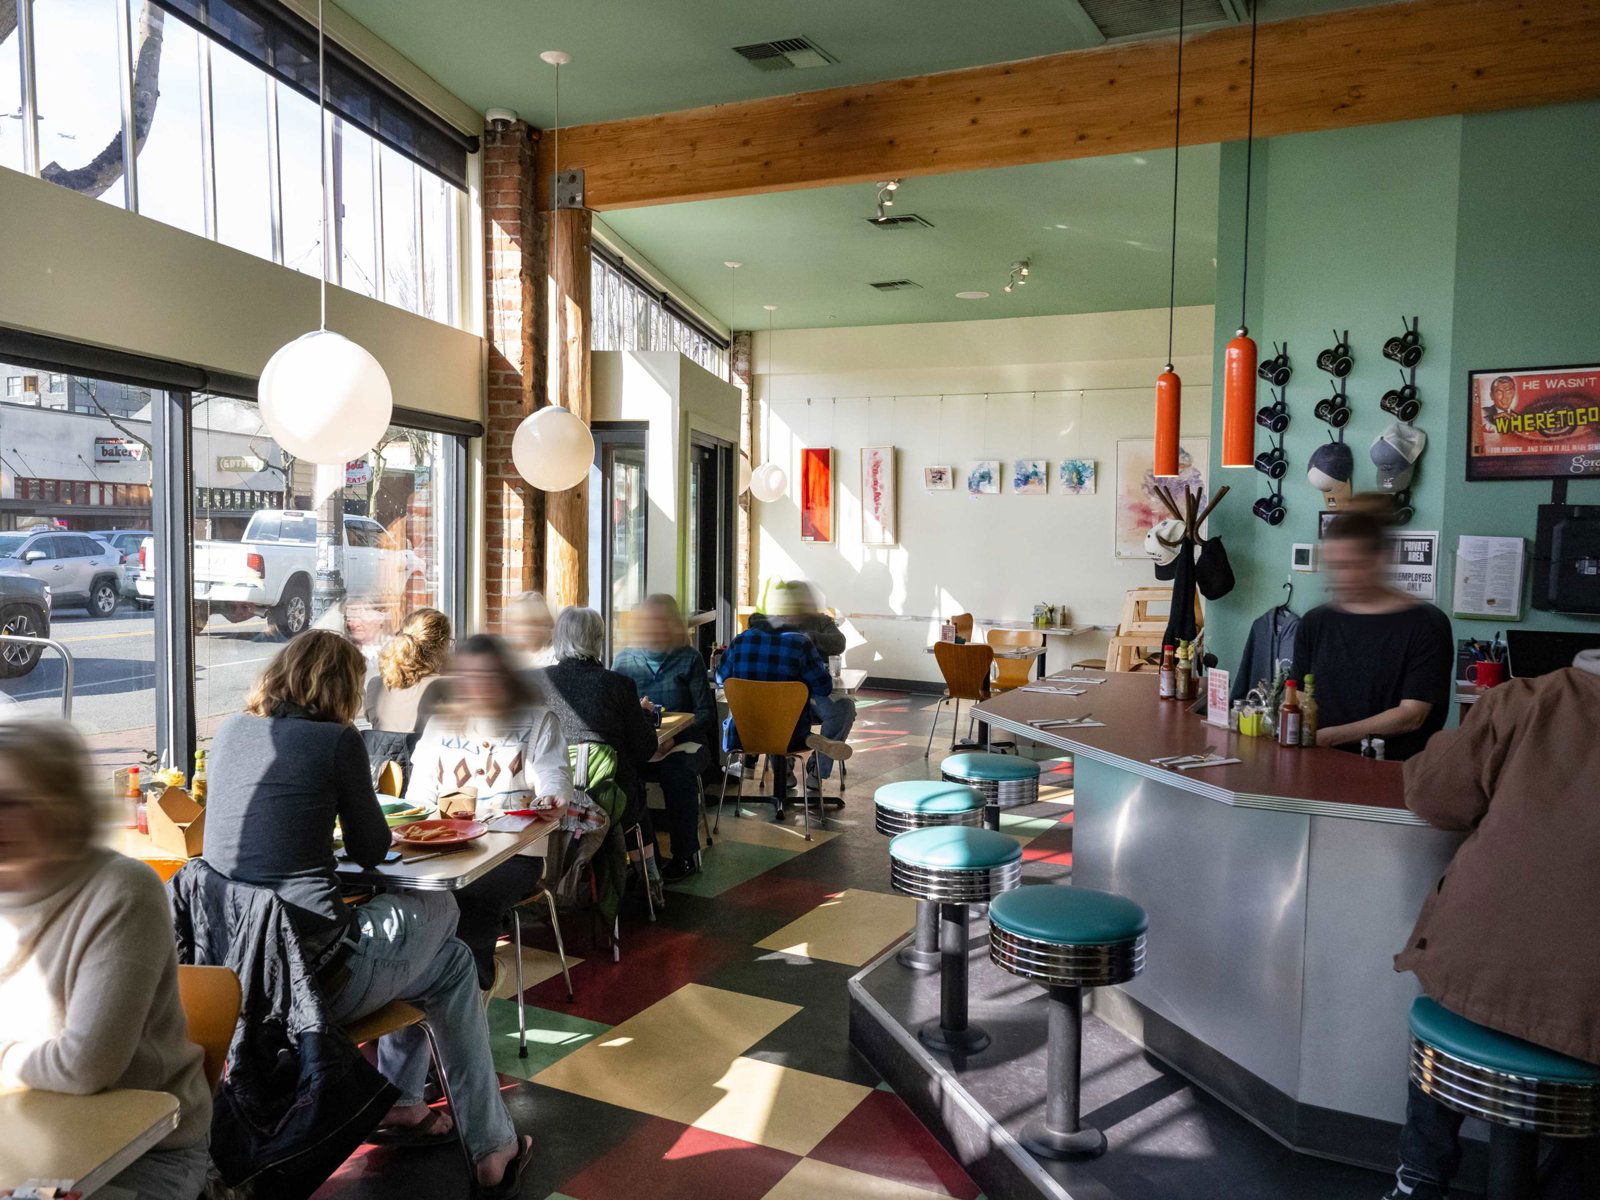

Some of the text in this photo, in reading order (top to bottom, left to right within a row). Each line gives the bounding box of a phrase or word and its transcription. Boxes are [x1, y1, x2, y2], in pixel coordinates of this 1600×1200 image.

[1522, 377, 1597, 390] HE WASN'T
[101, 446, 142, 460] bakery
[1404, 541, 1430, 552] PRIVATE
[1408, 551, 1425, 562] AREA
[1398, 572, 1432, 583] EMPLOYEES
[1407, 583, 1422, 592] ONLY
